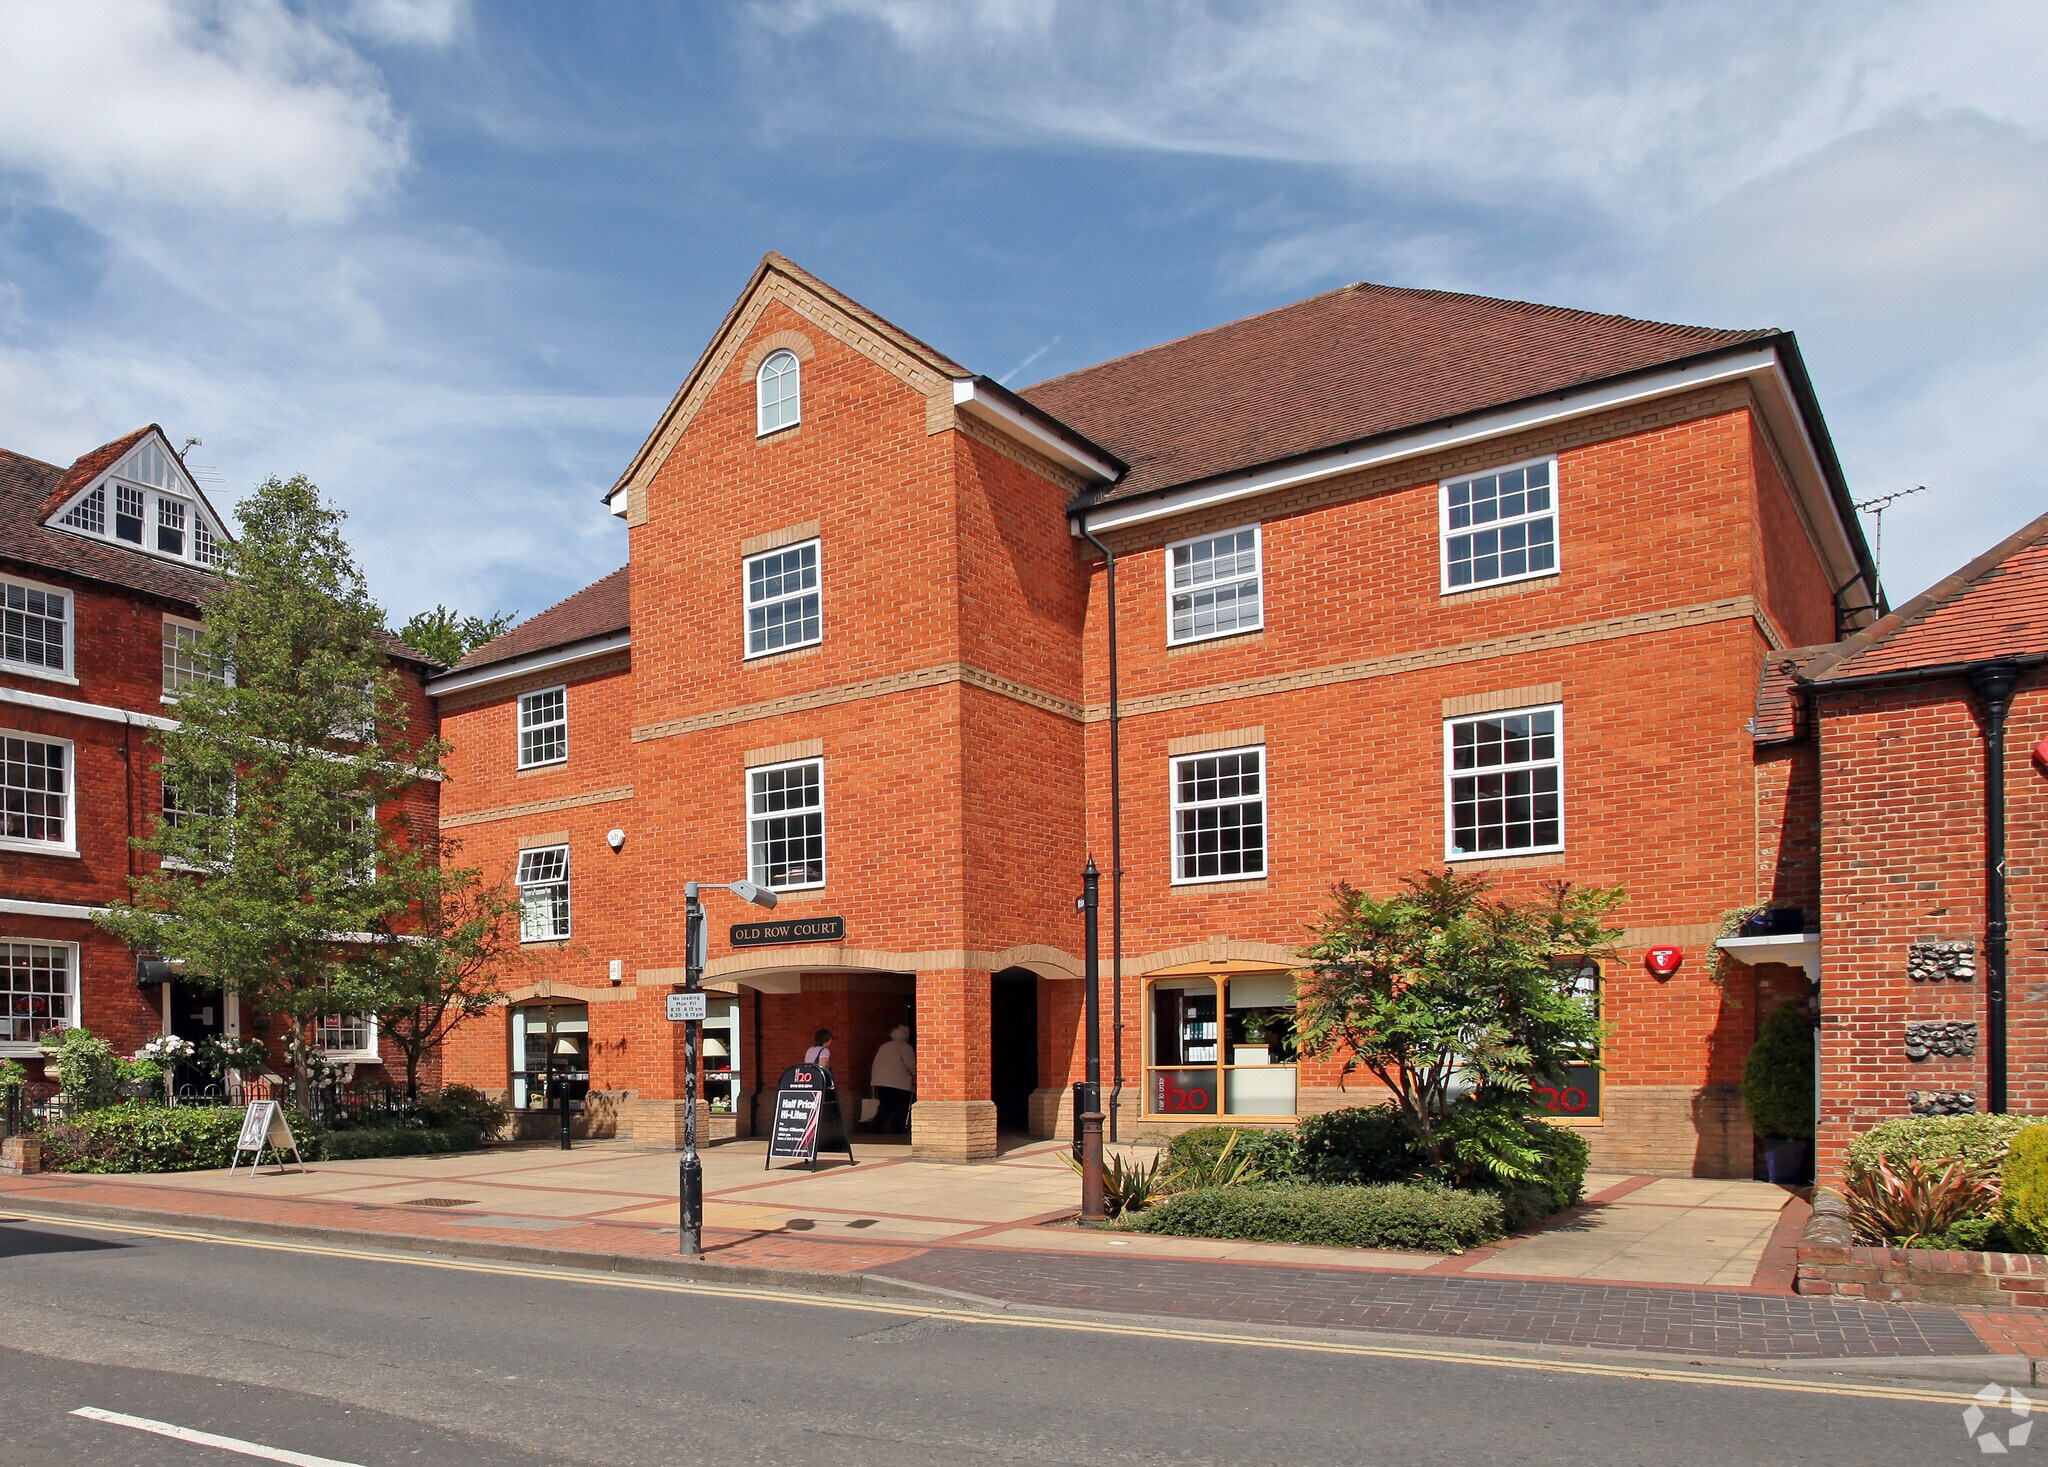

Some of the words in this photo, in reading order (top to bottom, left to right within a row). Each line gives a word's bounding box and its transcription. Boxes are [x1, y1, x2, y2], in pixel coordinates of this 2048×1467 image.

[735, 929, 760, 940] OLD
[764, 926, 790, 938] ROW
[794, 922, 837, 936] COURT
[782, 1099, 796, 1108] Half
[797, 1100, 816, 1109] Price
[780, 1109, 808, 1120] Hi-Lites
